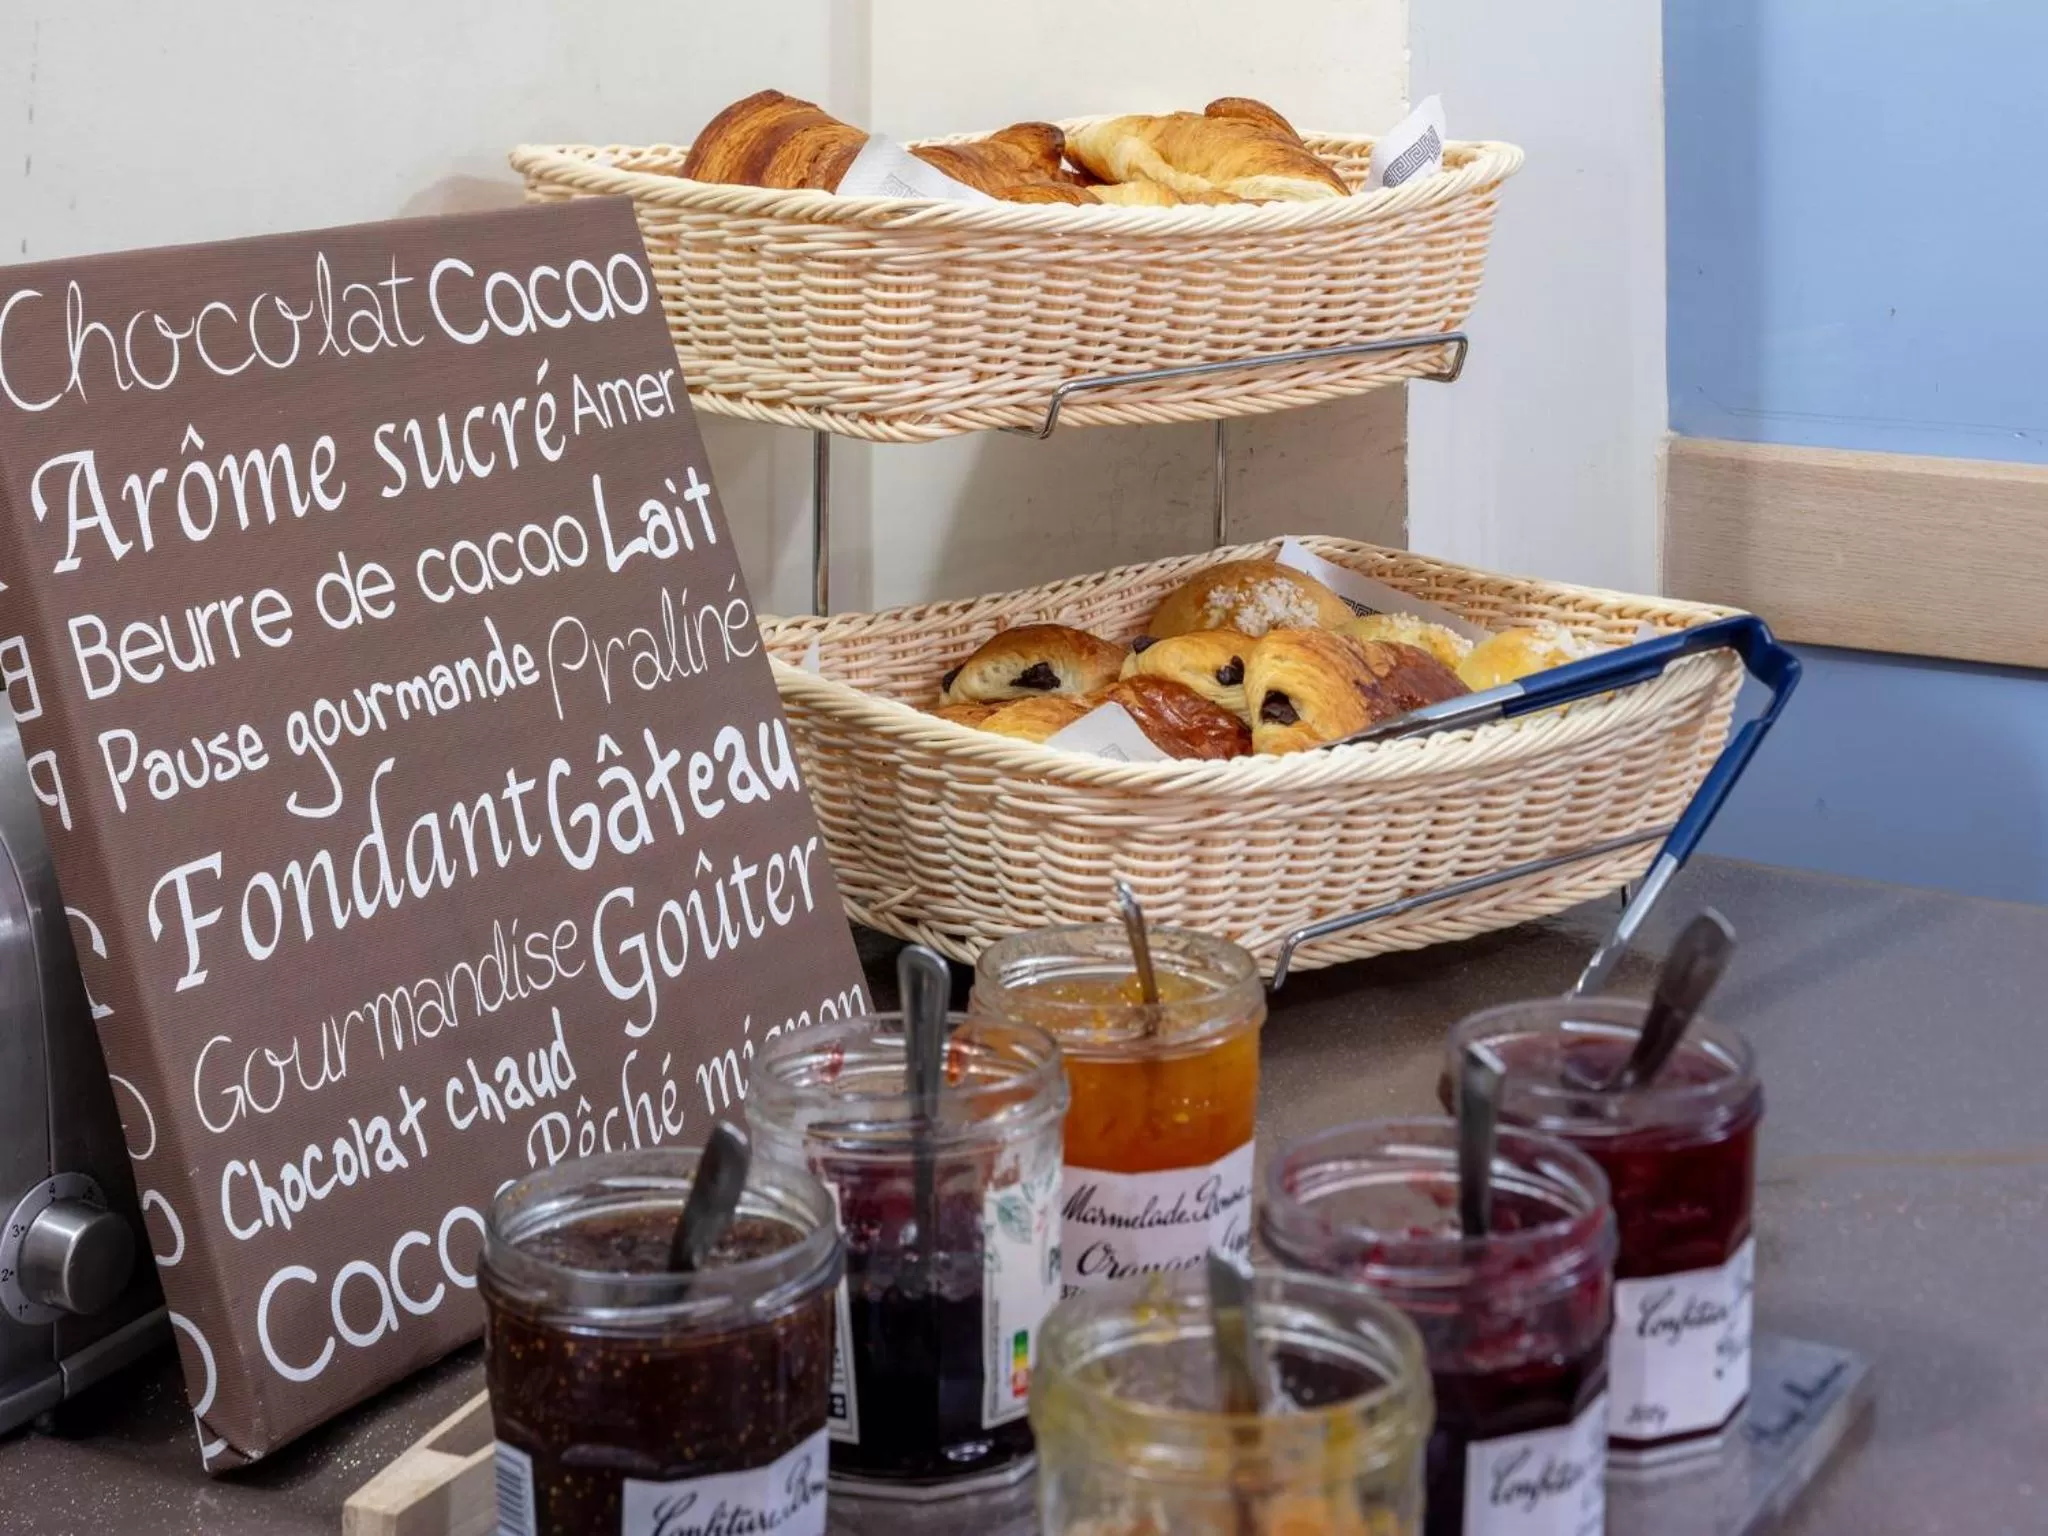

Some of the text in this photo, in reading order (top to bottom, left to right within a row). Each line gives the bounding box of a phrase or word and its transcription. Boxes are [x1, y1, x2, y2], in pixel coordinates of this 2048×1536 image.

[0, 251, 649, 412] Chocolat Cacao
[30, 358, 676, 574] Arôme sucré Amer
[67, 466, 717, 700] Beurre de cacao Lait
[97, 574, 758, 819] Pause gourmande Praliné
[148, 757, 542, 992] Fondant
[547, 718, 799, 870] Gâteau
[193, 918, 586, 1133] Gourmandise
[592, 836, 818, 1038] Goûter
[221, 1085, 428, 1241] Chocolat
[446, 1006, 577, 1131] chaud
[1062, 1184, 1190, 1230] Marmelade
